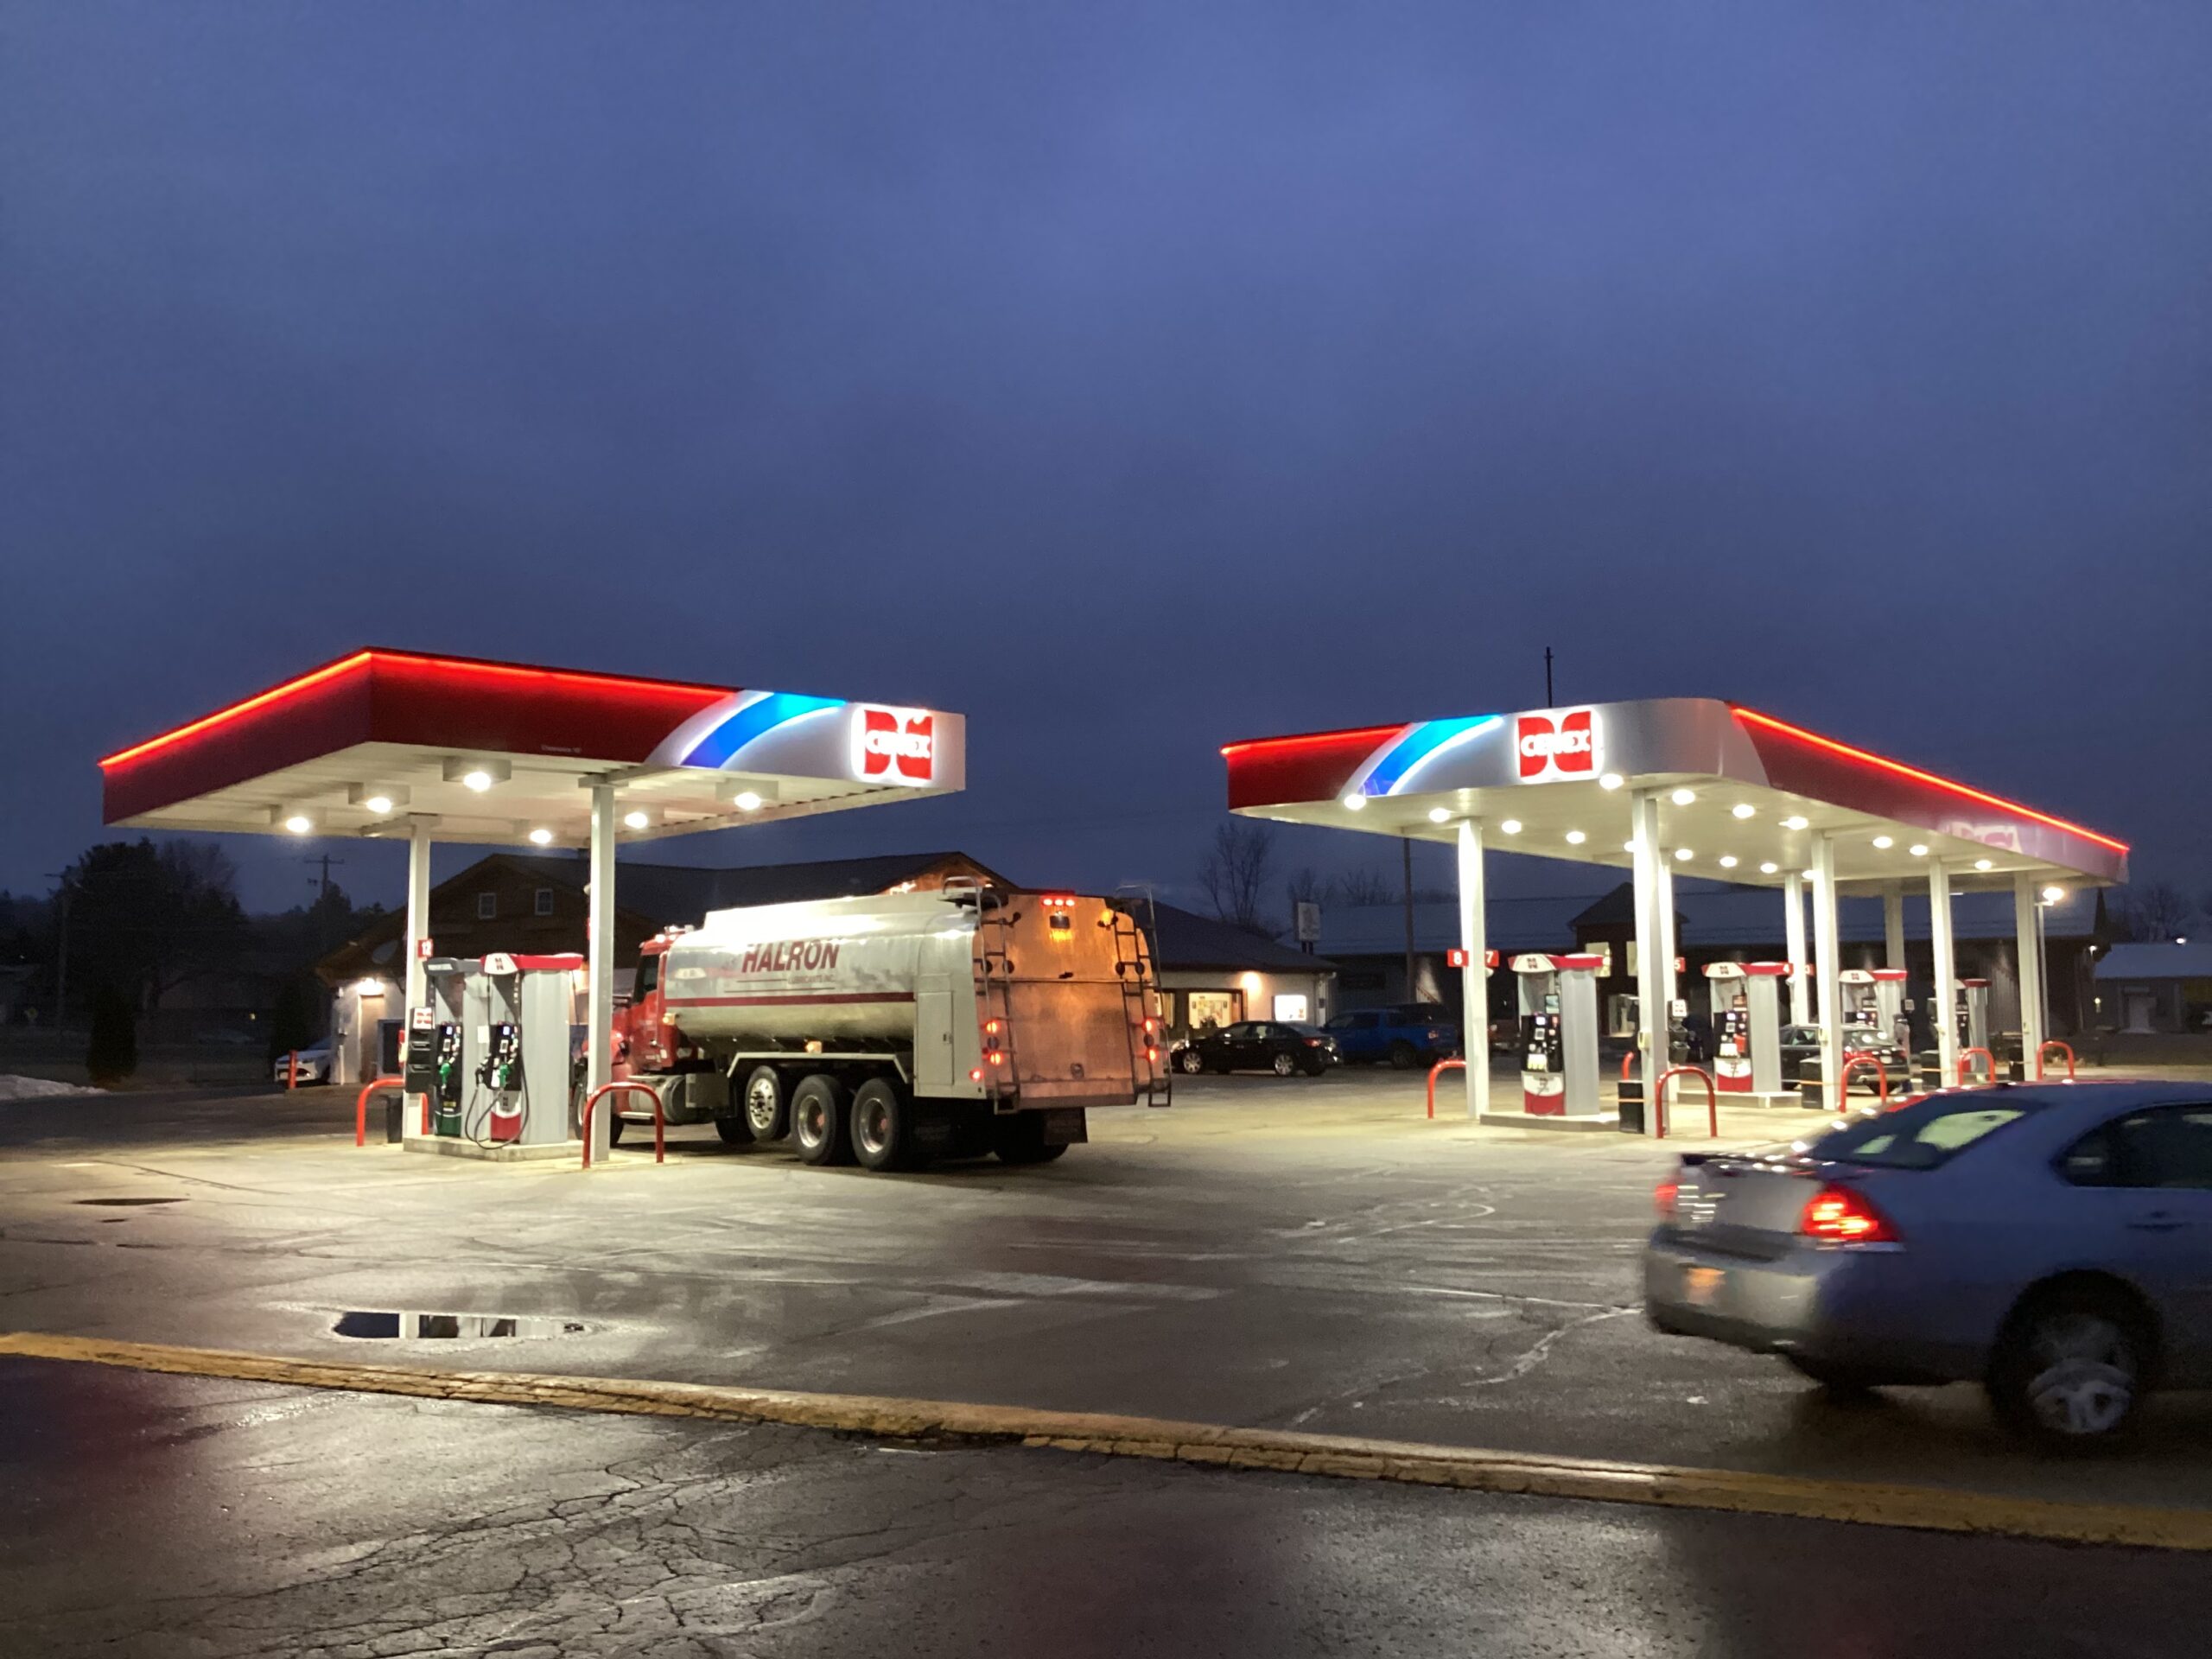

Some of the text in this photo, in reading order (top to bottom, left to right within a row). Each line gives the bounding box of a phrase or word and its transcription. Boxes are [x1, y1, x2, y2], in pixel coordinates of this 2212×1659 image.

[741, 939, 840, 973] HALRON
[1453, 951, 1463, 965] 8
[1485, 950, 1494, 964] 7
